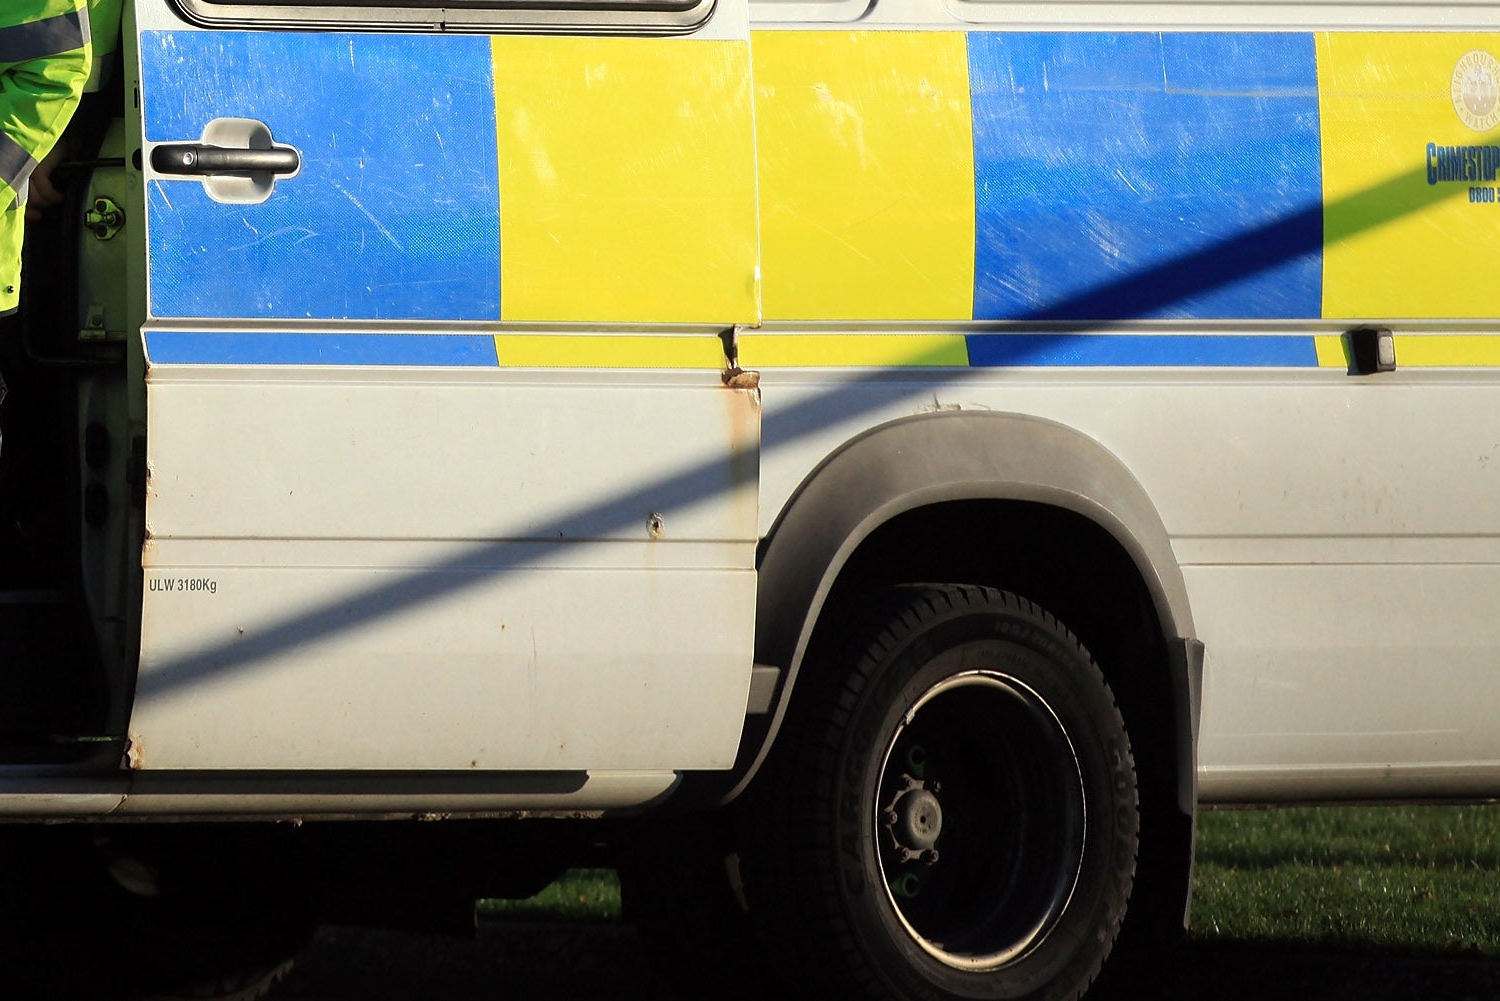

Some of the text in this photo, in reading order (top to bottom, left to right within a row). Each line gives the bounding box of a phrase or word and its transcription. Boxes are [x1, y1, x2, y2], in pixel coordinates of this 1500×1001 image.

[1452, 53, 1500, 104] NEIGHBOURH
[1465, 111, 1498, 129] WATCH
[1468, 186, 1495, 203] 0800
[149, 578, 217, 594] ULW 3180Kg
